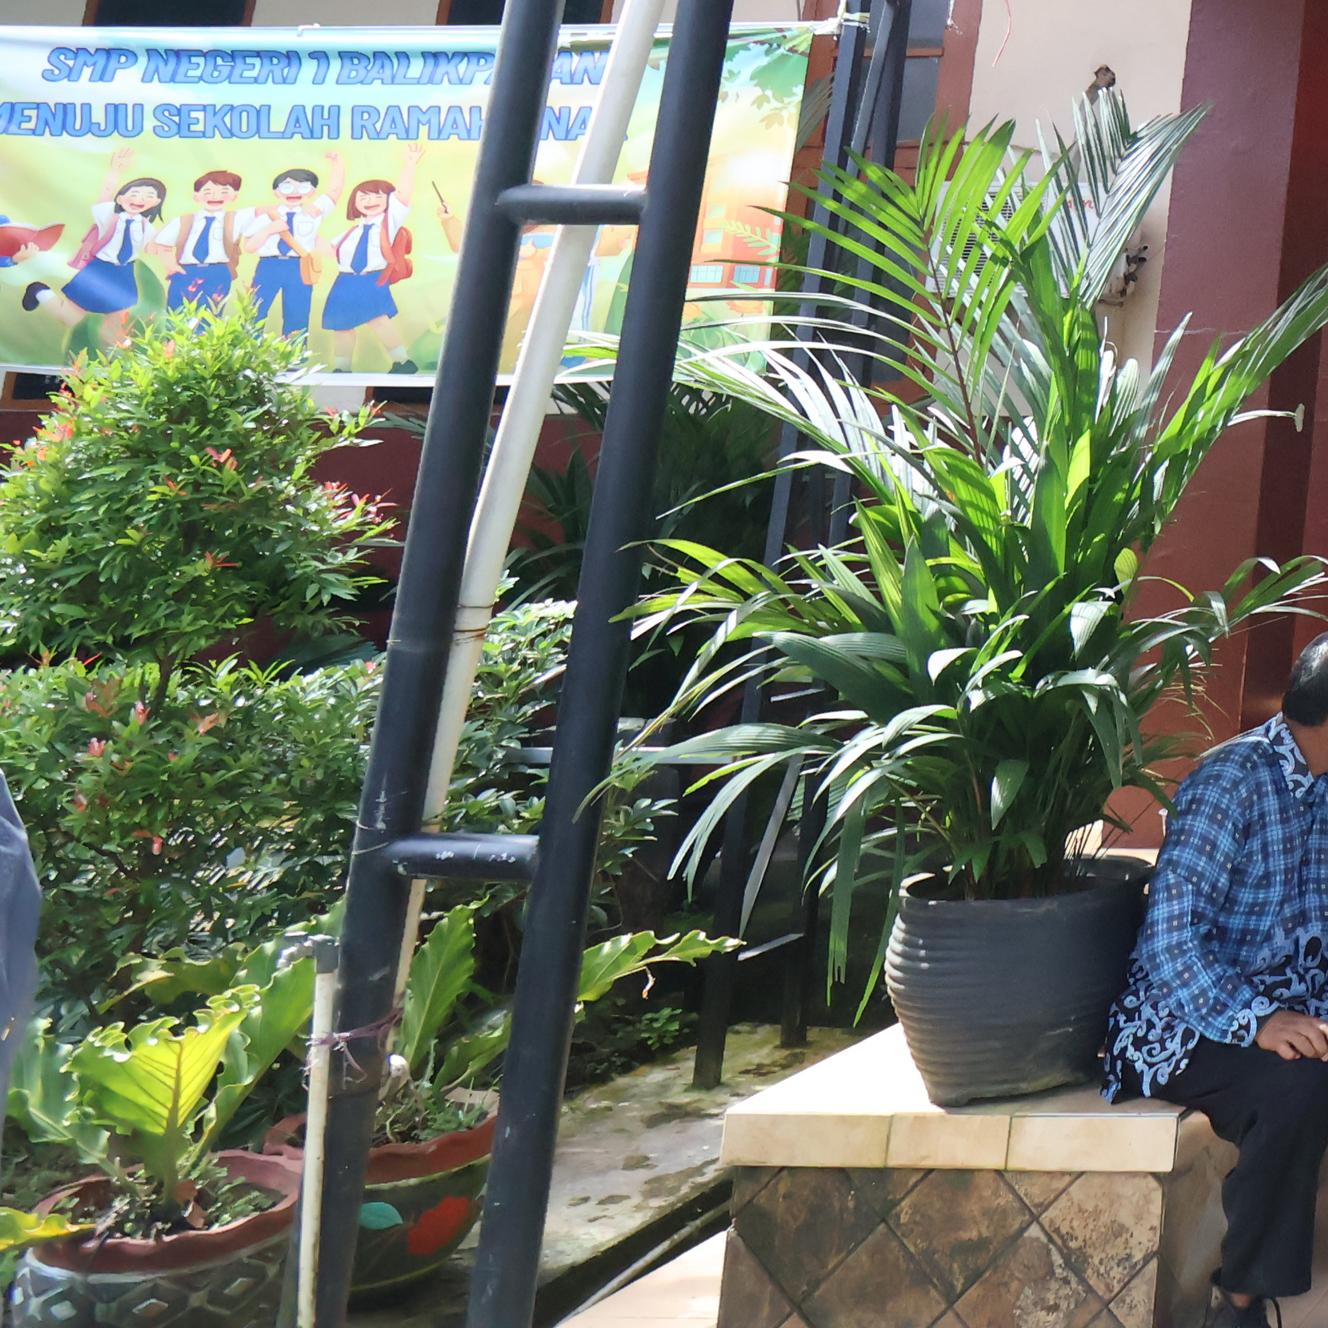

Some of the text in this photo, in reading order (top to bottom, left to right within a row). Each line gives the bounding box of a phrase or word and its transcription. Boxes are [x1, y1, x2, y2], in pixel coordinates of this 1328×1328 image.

[41, 47, 612, 86] SMP NEGERI 1 BALIKPAN
[152, 103, 340, 140] SEKOLAH
